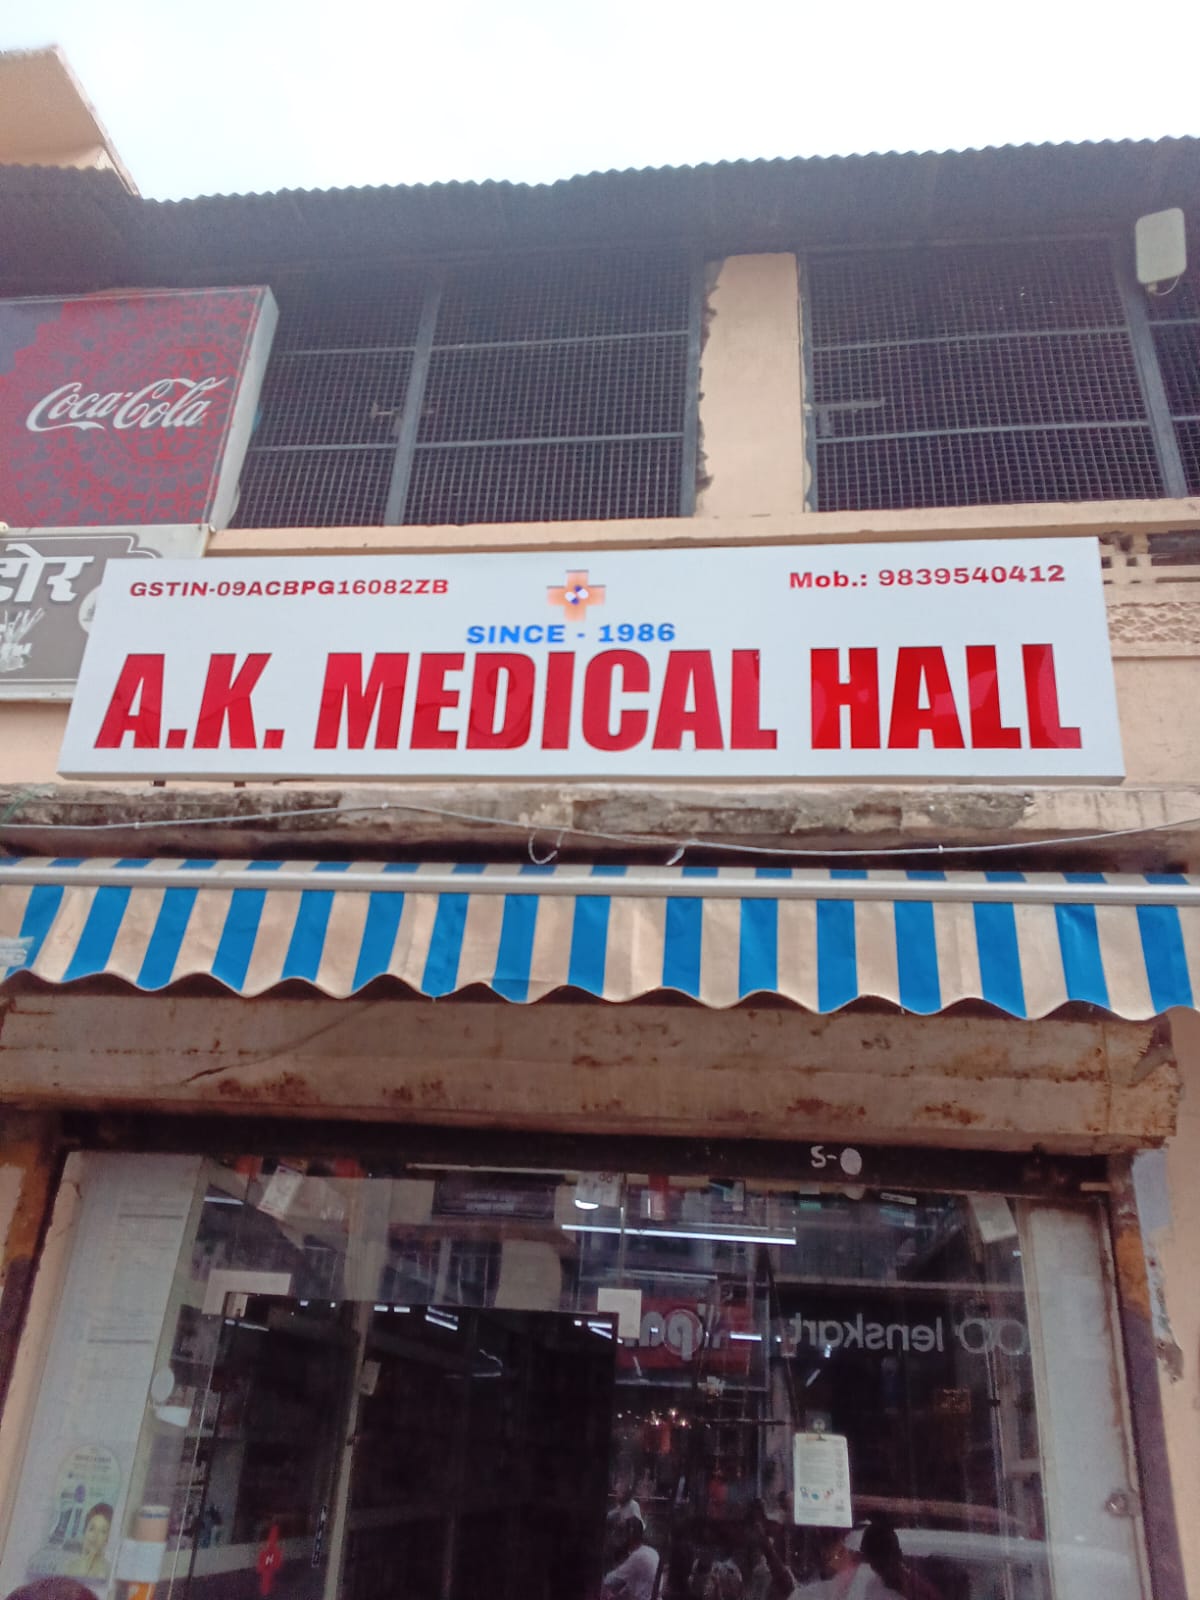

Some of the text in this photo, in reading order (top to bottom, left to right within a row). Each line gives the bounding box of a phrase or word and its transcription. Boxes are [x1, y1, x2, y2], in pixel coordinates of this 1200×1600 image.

[26, 376, 230, 432] Coca-Cola
[129, 579, 449, 597] GSTIN-09ACBPG16082ZB
[789, 564, 1066, 589] Mob.: 9839540412
[466, 624, 566, 644] SINCE
[598, 623, 676, 643] 1986
[93, 643, 1083, 750] A.K. MEDICAL HALL
